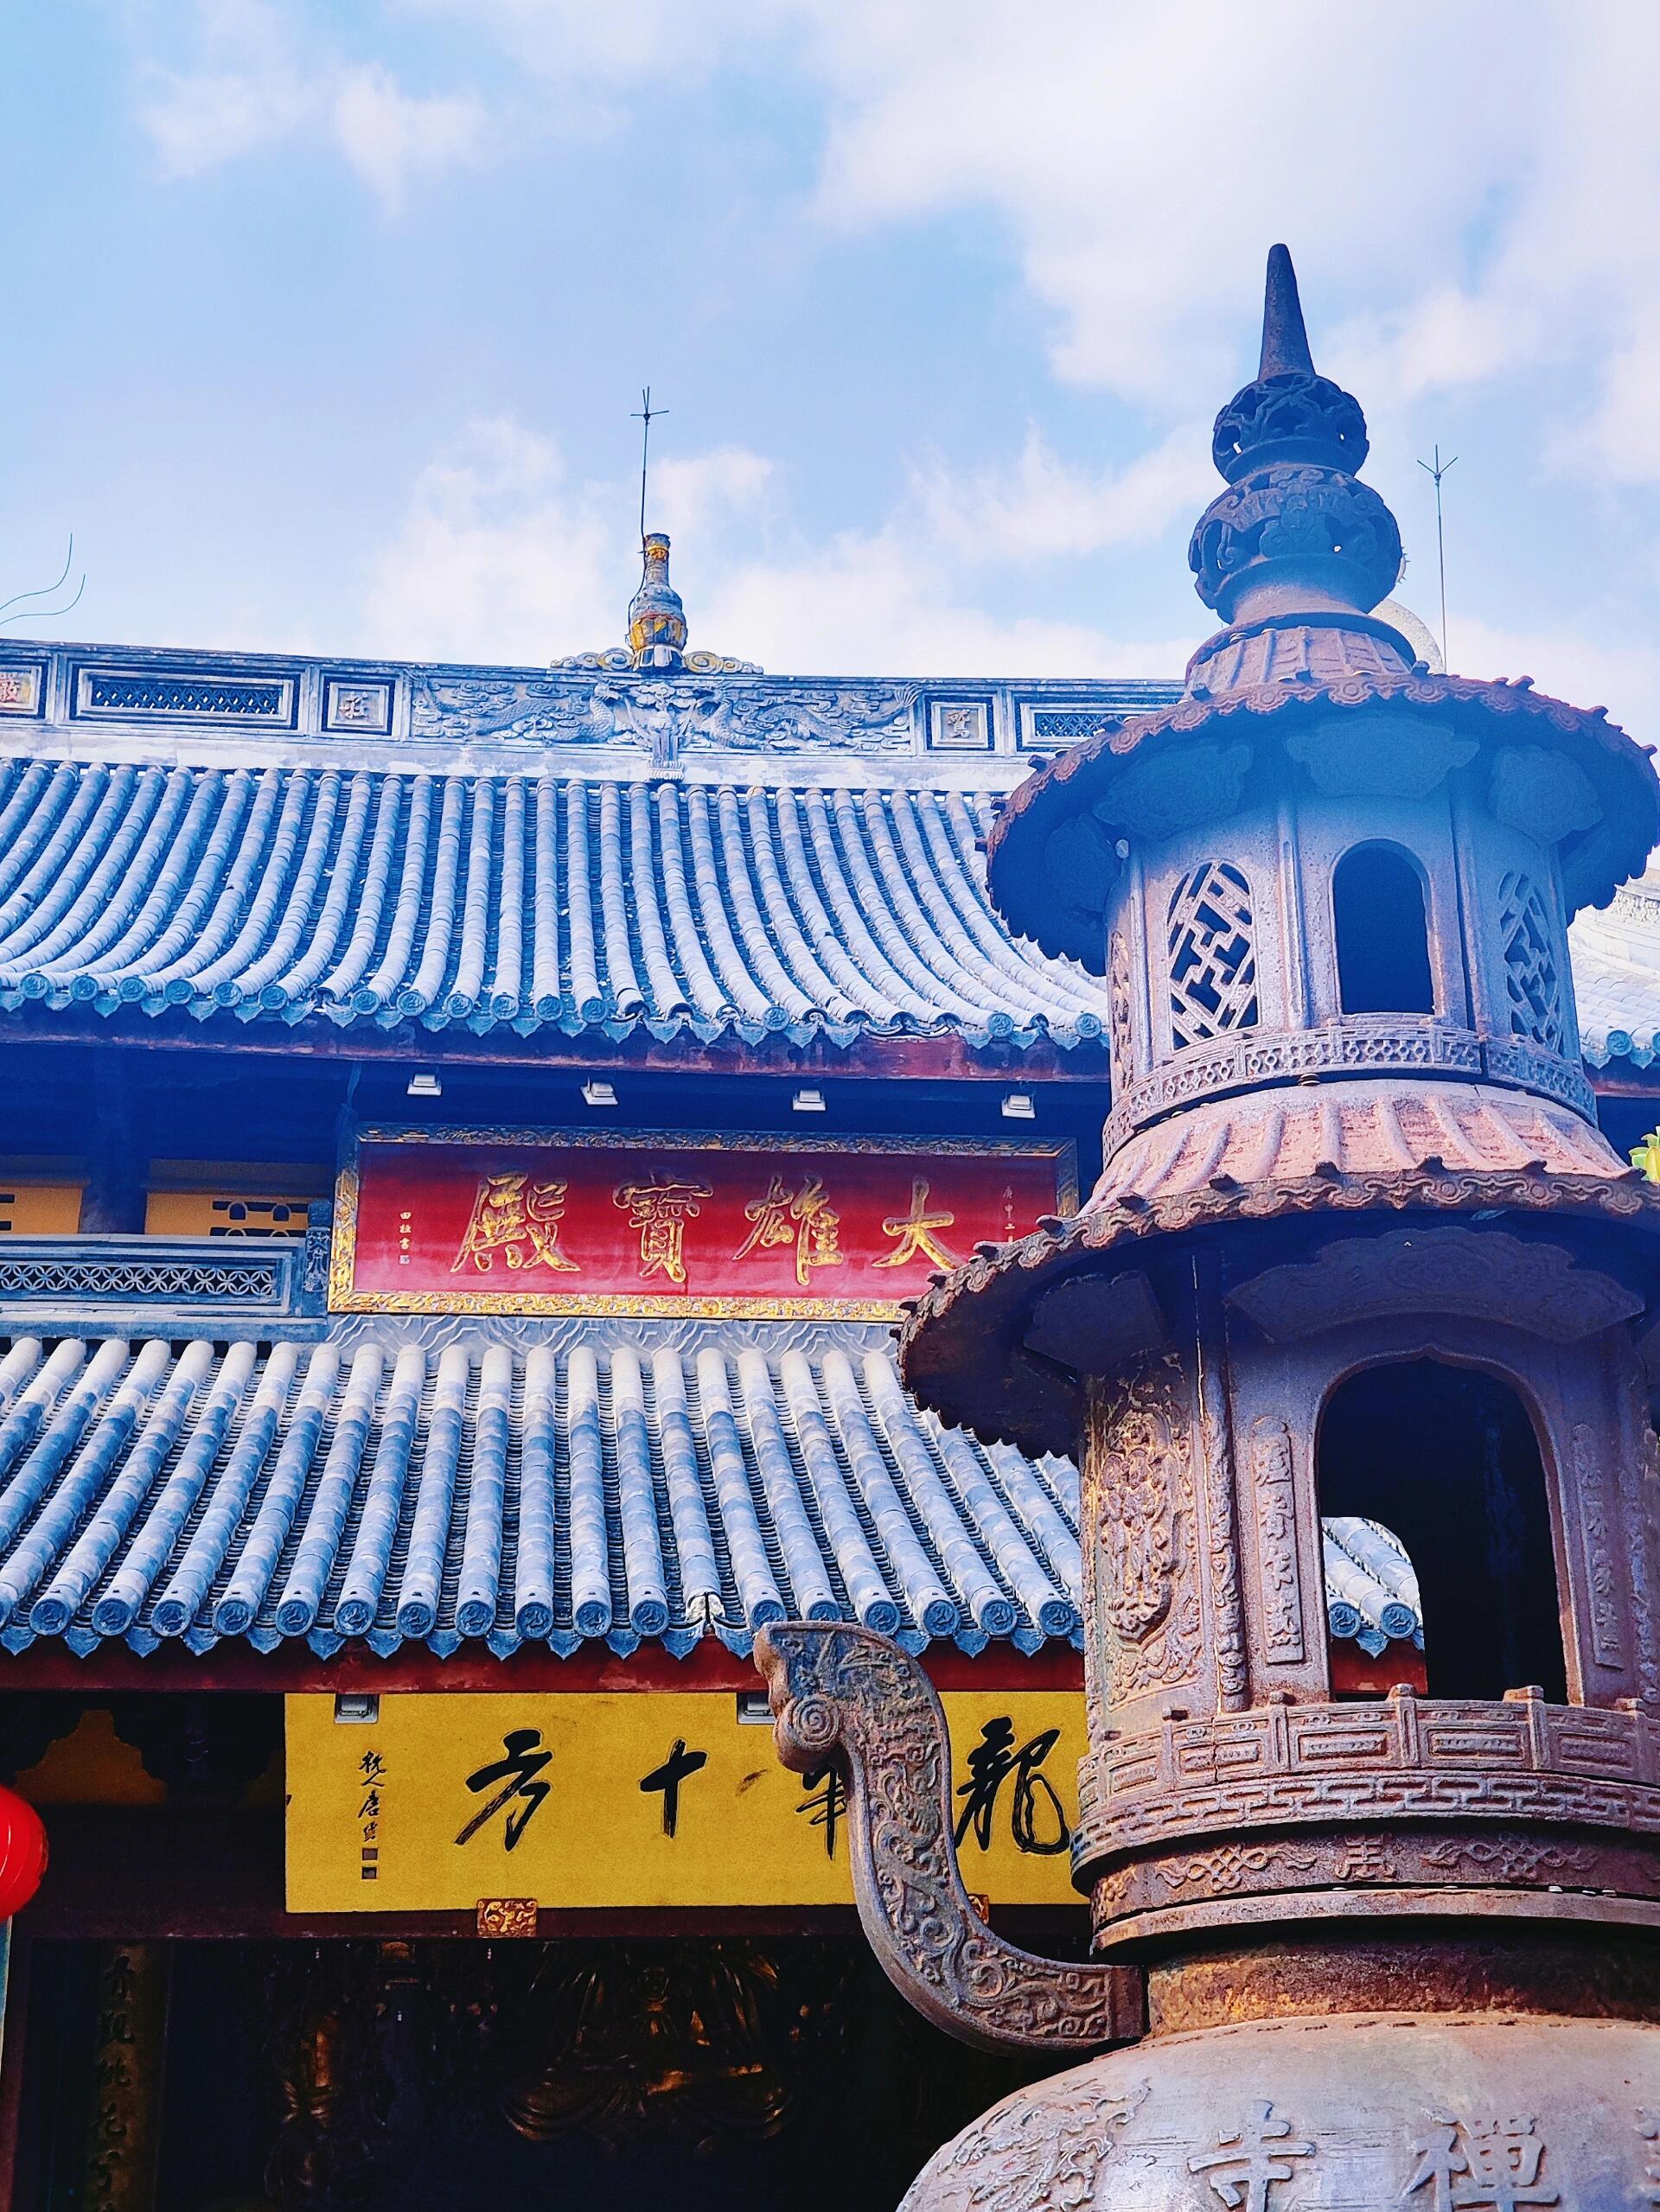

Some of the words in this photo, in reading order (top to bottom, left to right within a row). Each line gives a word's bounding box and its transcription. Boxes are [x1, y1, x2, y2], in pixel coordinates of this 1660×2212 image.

[450, 1170, 966, 1285] 大雄寶殿
[1188, 2099, 1660, 2212] 禪寺
